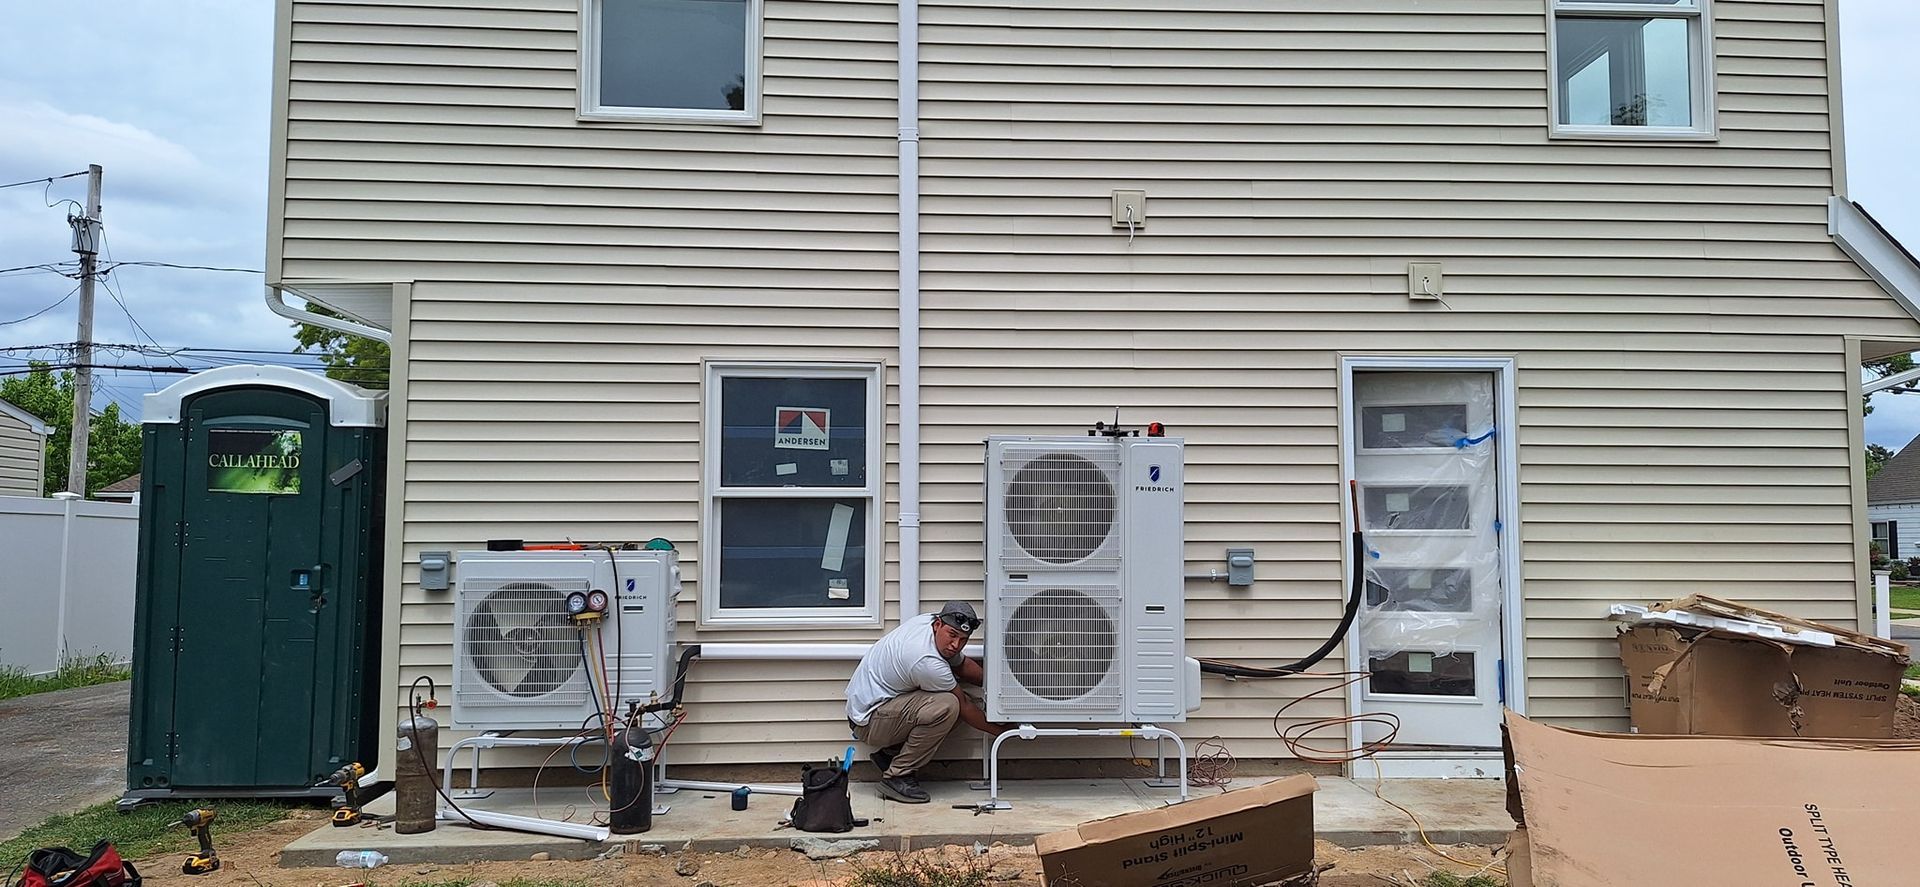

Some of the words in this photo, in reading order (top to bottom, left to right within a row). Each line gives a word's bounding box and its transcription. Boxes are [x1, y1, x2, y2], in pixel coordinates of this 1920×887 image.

[778, 437, 826, 446] ANDERSEN
[208, 454, 300, 469] CALLAHEAD
[1854, 680, 1890, 690] Outdoor
[1811, 690, 1832, 698] HEAT
[1832, 690, 1864, 700] SYSTEM
[1866, 694, 1888, 702] SPLIT
[1149, 833, 1185, 850] High
[1804, 803, 1828, 835] SPLIT
[1818, 836, 1842, 865] TYPE
[1173, 831, 1244, 858] Mini-Split
[1122, 852, 1168, 869] Stand
[1778, 827, 1809, 879] Outdoor
